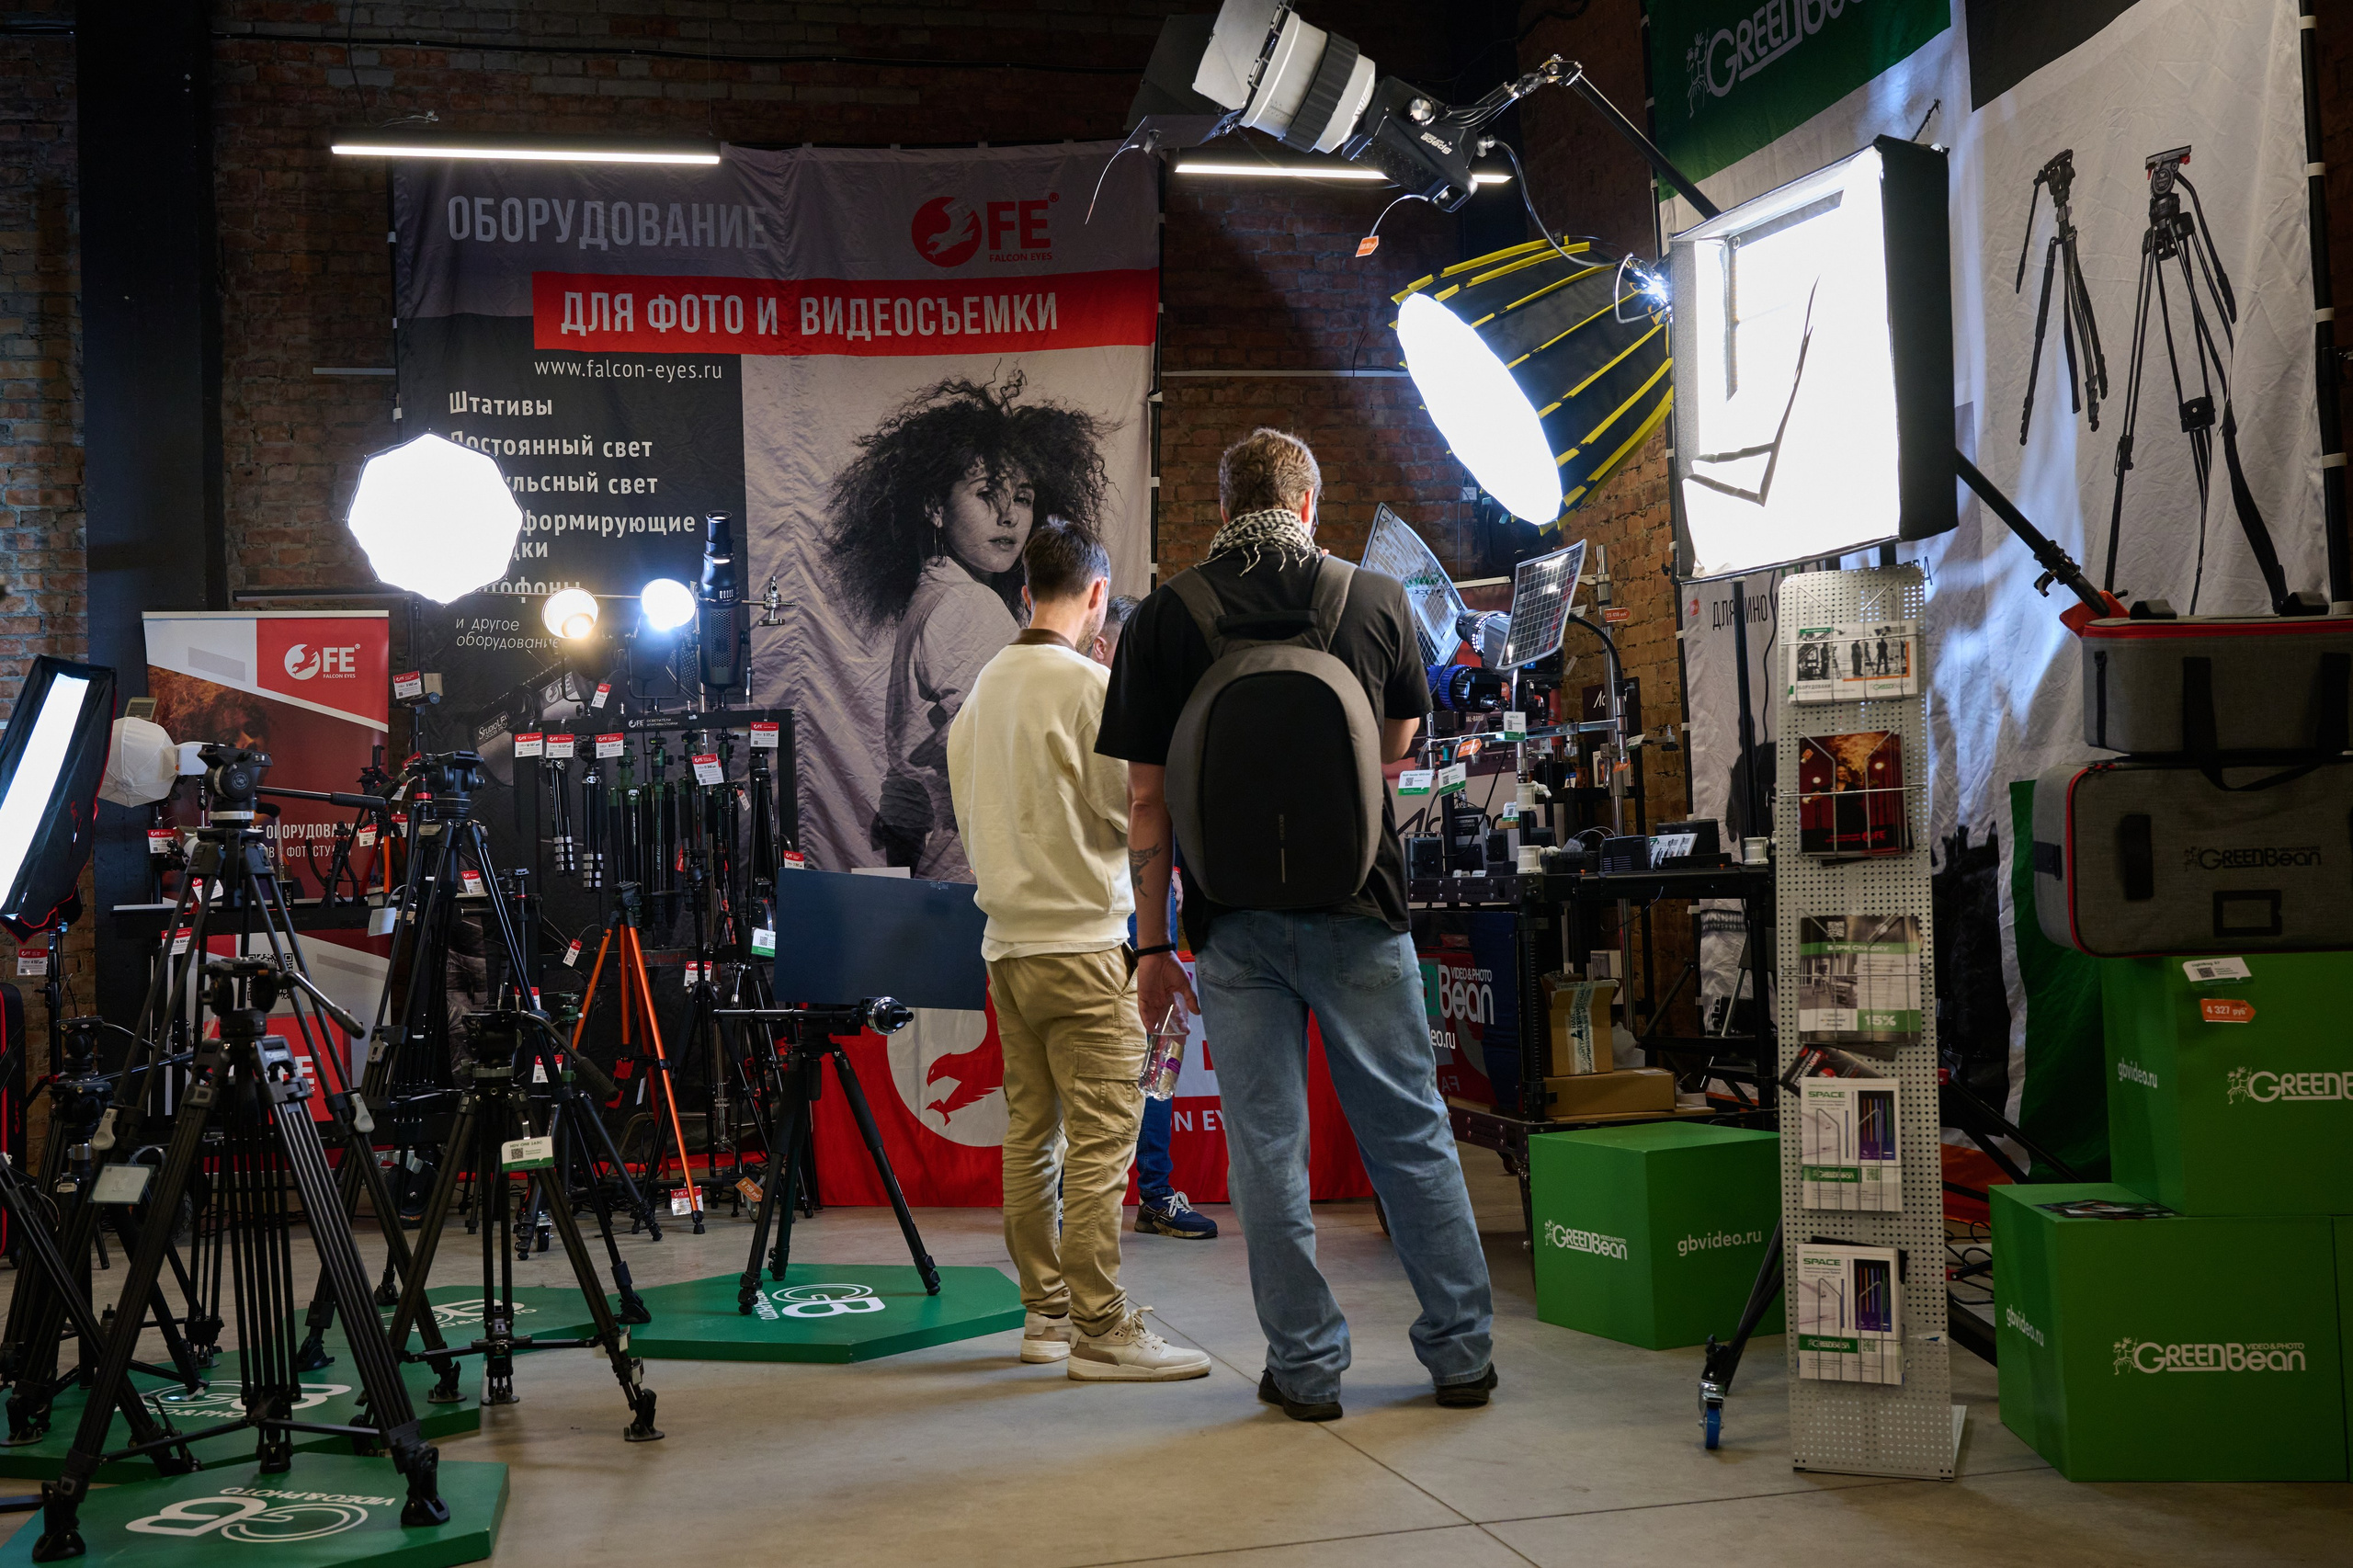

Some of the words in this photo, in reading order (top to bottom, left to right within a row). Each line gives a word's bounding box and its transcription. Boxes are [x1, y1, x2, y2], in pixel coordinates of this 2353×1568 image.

[448, 195, 768, 251] ОБОРУДОВАНИЕ
[989, 253, 1028, 263] FALCON
[1030, 252, 1052, 261] EYES
[561, 290, 634, 336] ДЛЯ
[647, 294, 744, 335] ФОТО
[756, 296, 779, 335] И
[800, 292, 1058, 341] ВИДЕОСЪЕМКИ
[534, 359, 722, 382] www.falcon-eyes.ru
[449, 391, 552, 416] Штативы
[602, 441, 653, 458] свет
[506, 472, 598, 493] льсный
[608, 477, 658, 494] свет
[522, 509, 696, 538] формирующие
[1744, 594, 1768, 623] ИНО
[455, 619, 464, 629] и
[472, 618, 520, 633] другое
[323, 646, 356, 672] FE
[1864, 1015, 1897, 1027] 15%
[2206, 1006, 2213, 1015] 4
[2214, 1006, 2230, 1015] 327
[1429, 1024, 1456, 1050] eo.ru
[2117, 1058, 2158, 1089] gbvideo.ru
[1677, 1231, 1763, 1257] gbvideo.ru
[1802, 1257, 1842, 1267] SPACE
[2006, 1303, 2045, 1347] gbvideo.ru
